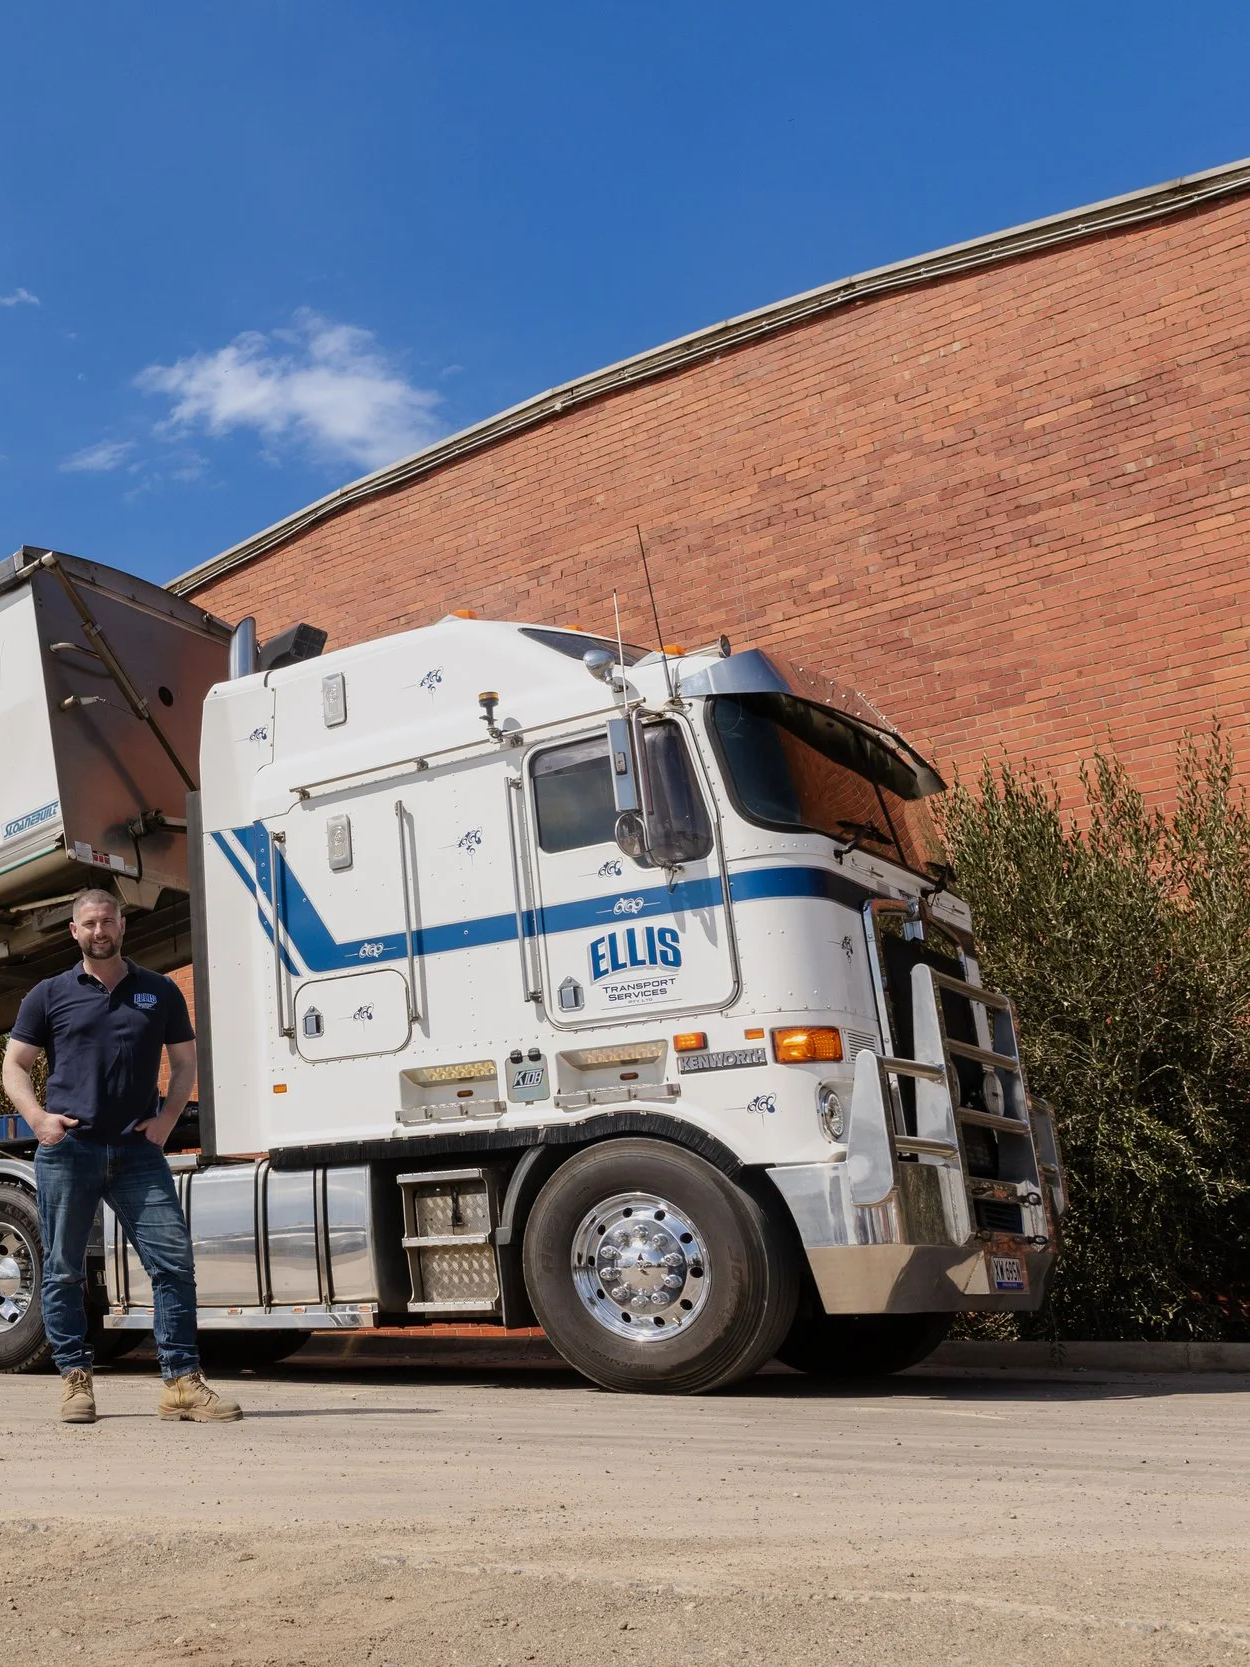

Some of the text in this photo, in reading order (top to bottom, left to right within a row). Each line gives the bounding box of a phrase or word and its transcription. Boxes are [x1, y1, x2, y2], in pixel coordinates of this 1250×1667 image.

[589, 926, 683, 982] ELLIS
[603, 978, 676, 994] TRANSPORT
[608, 987, 668, 1002] SERVICES
[680, 1050, 766, 1072] KENWORTH
[513, 1070, 543, 1088] K108
